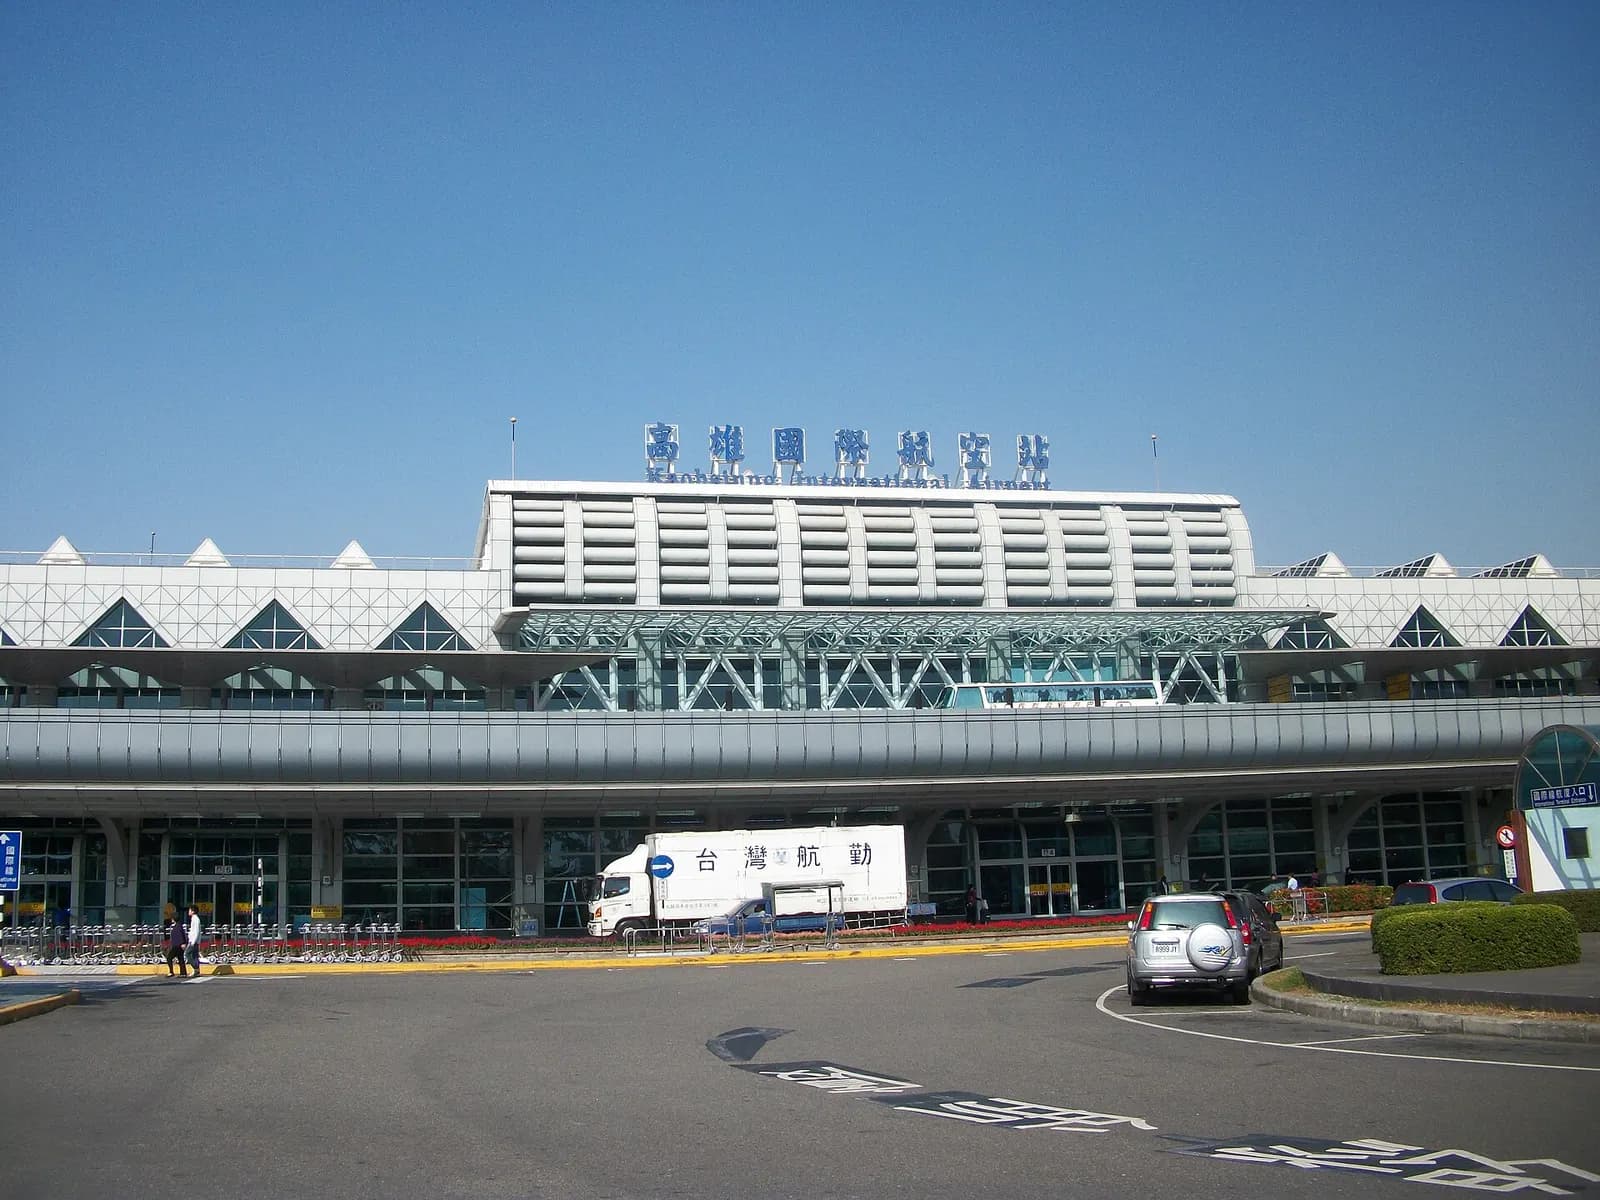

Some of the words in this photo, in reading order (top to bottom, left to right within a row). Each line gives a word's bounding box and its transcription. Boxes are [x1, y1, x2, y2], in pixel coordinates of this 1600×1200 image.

[646, 422, 1049, 469] 高雄國際航空站
